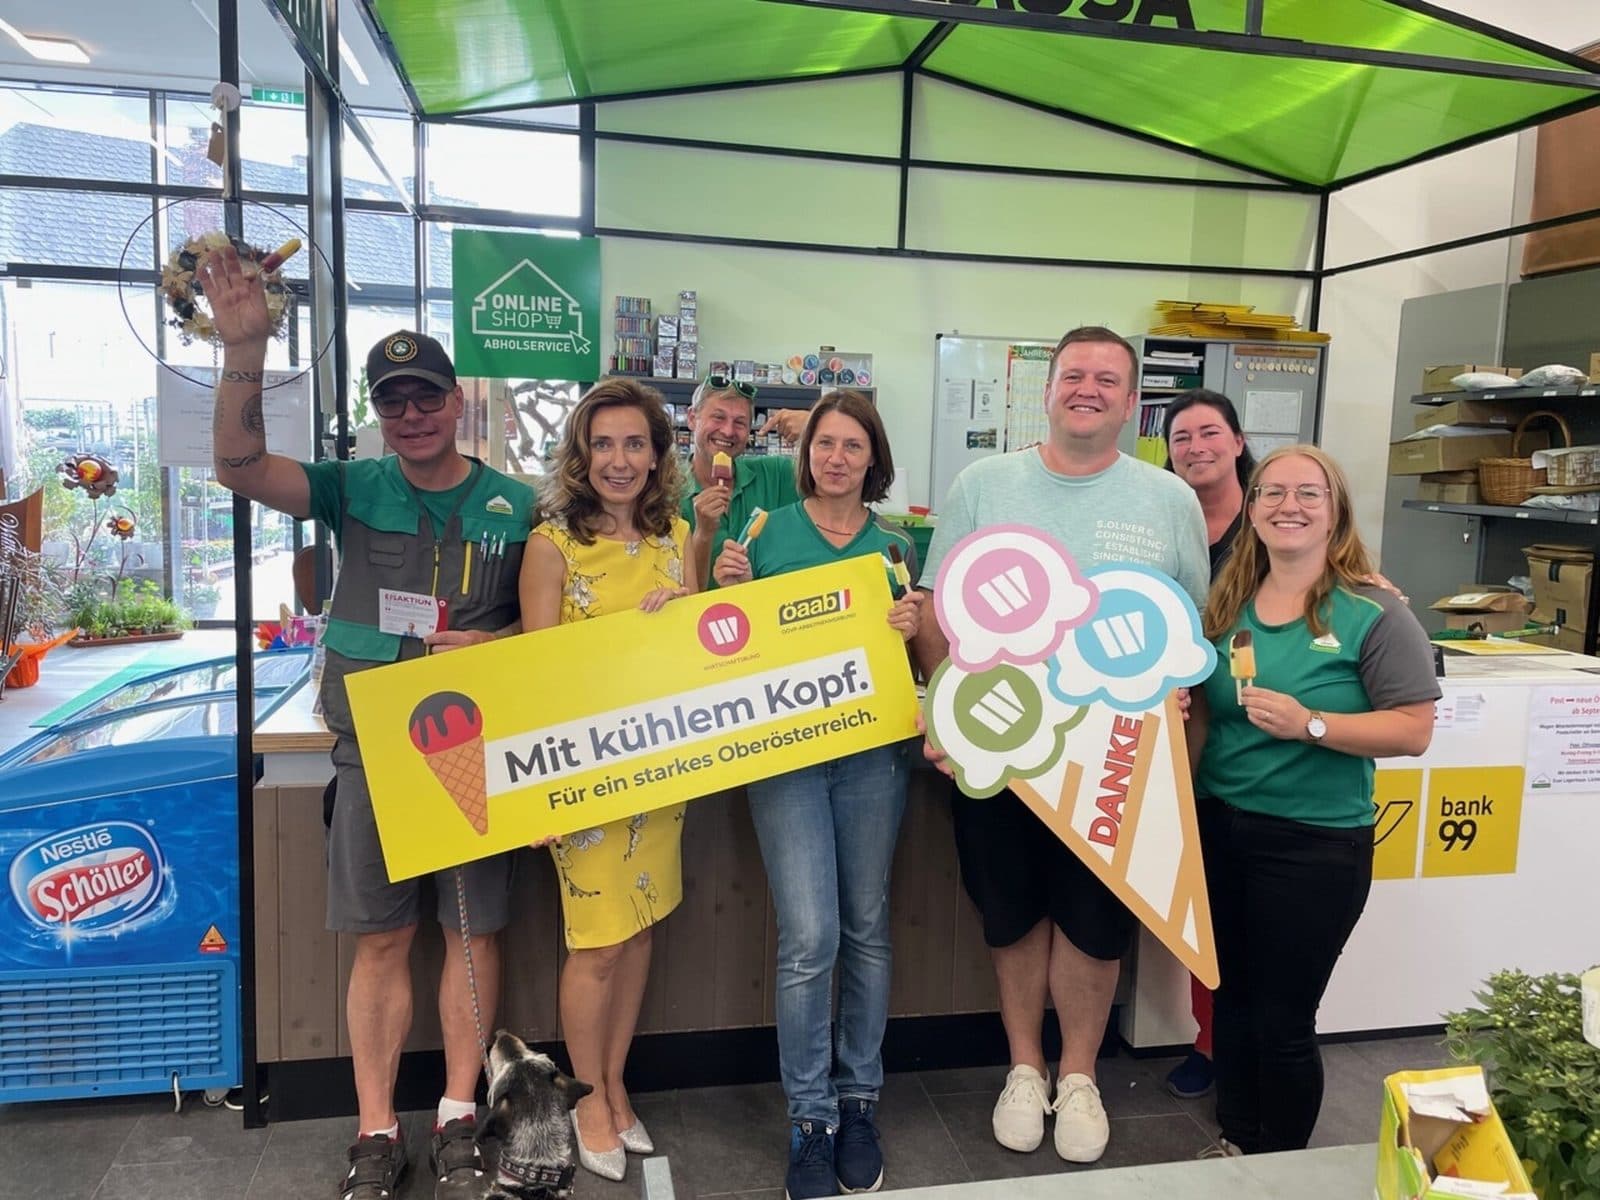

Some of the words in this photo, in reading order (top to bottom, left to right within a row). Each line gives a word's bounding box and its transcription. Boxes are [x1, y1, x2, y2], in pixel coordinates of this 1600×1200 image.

[492, 294, 562, 312] ONLINE
[491, 311, 543, 328] SHOP
[484, 339, 571, 352] ABHOLSERVICE
[1095, 530, 1168, 551] CONSISTENCY
[781, 594, 837, 622] öaab
[504, 735, 581, 784] Mit
[588, 695, 756, 760] kühlem
[763, 660, 870, 714] Kopf.
[548, 784, 587, 809] Für
[593, 774, 629, 797] ein
[633, 753, 714, 788] starkes
[717, 708, 878, 763] Oberösterreich.
[1087, 714, 1143, 848] DANKE
[1441, 794, 1494, 817] bank
[40, 828, 112, 864] Nestlé
[1439, 819, 1477, 852] 99
[37, 855, 146, 922] Schöller
